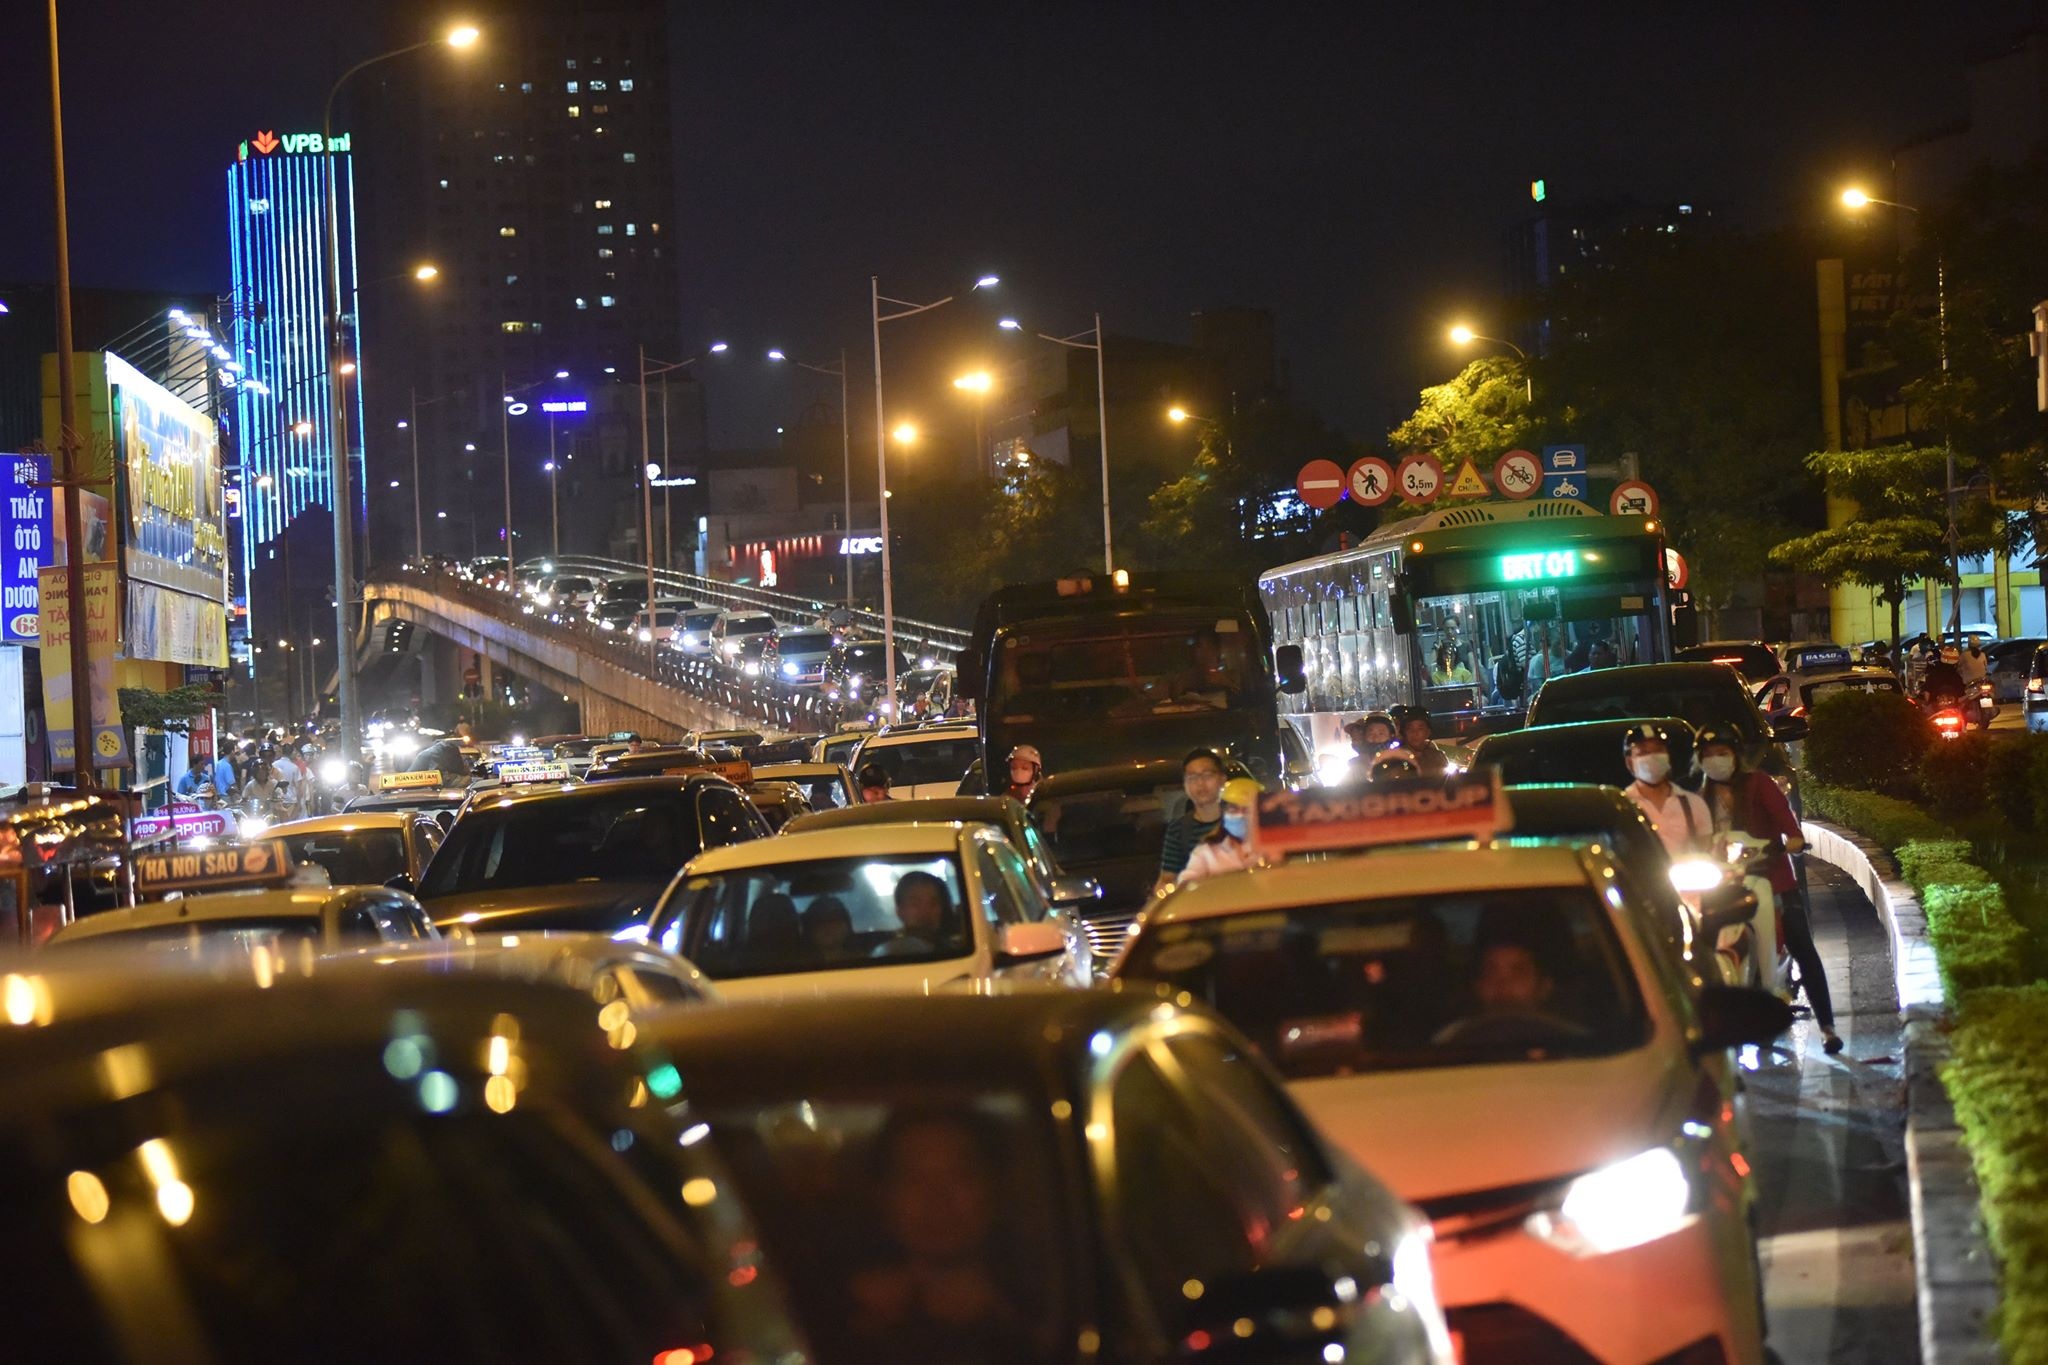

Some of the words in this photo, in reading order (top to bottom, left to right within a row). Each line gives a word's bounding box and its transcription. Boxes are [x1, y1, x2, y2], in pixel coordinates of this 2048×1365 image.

[10, 489, 44, 519] THẤT
[14, 524, 41, 550] ÔTÔ
[524, 773, 545, 781] LONG
[160, 819, 222, 837] ARPORT
[205, 851, 238, 874] SAO
